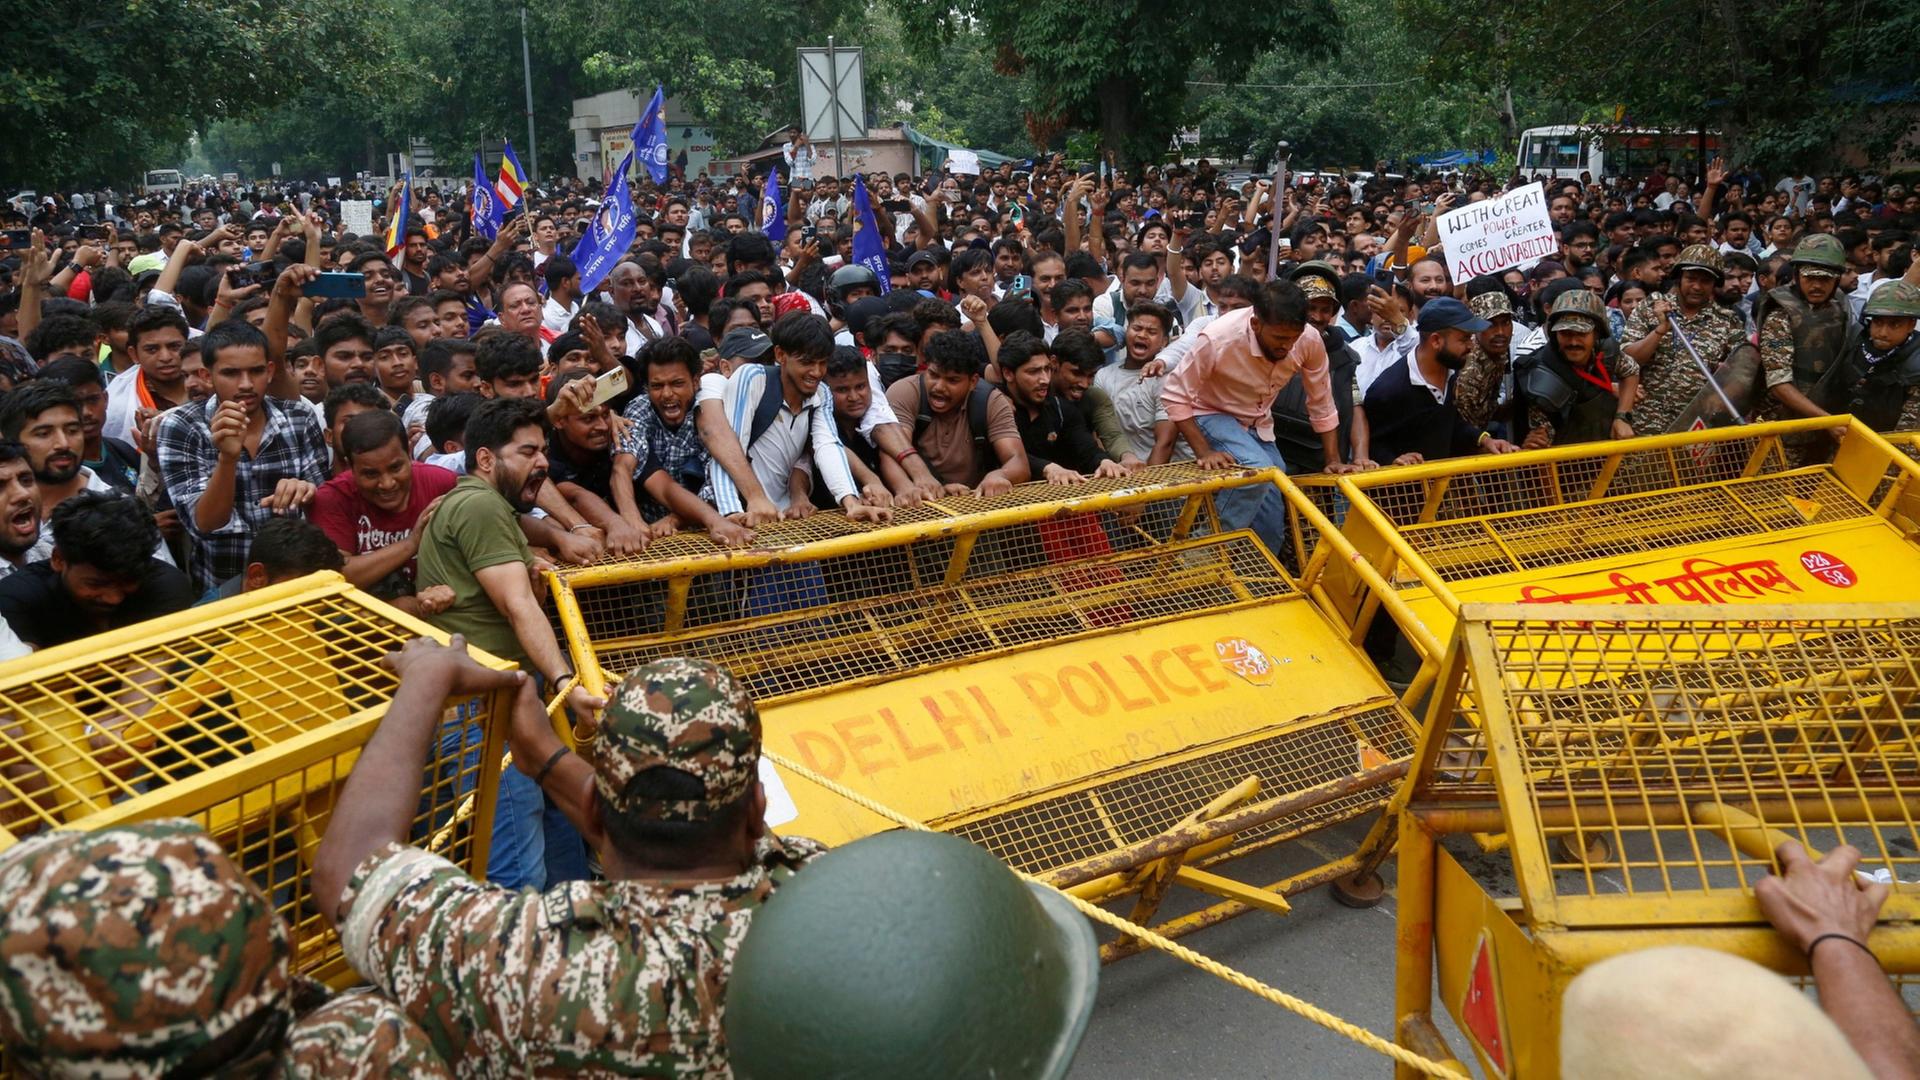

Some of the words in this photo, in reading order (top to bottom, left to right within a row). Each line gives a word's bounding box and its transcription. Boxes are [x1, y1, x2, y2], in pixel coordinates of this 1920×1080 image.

[1448, 206, 1489, 234] WITH
[1492, 190, 1540, 218] GREAT
[1483, 216, 1518, 236] POWER
[1457, 234, 1553, 282] ACCOUNTABILITY
[1459, 237, 1488, 254] COMES
[1504, 219, 1546, 240] GREATER
[1653, 558, 1804, 604] पलिस
[1823, 570, 1851, 585] 58
[790, 685, 1013, 780] DELHI
[1011, 643, 1231, 728] POLICE
